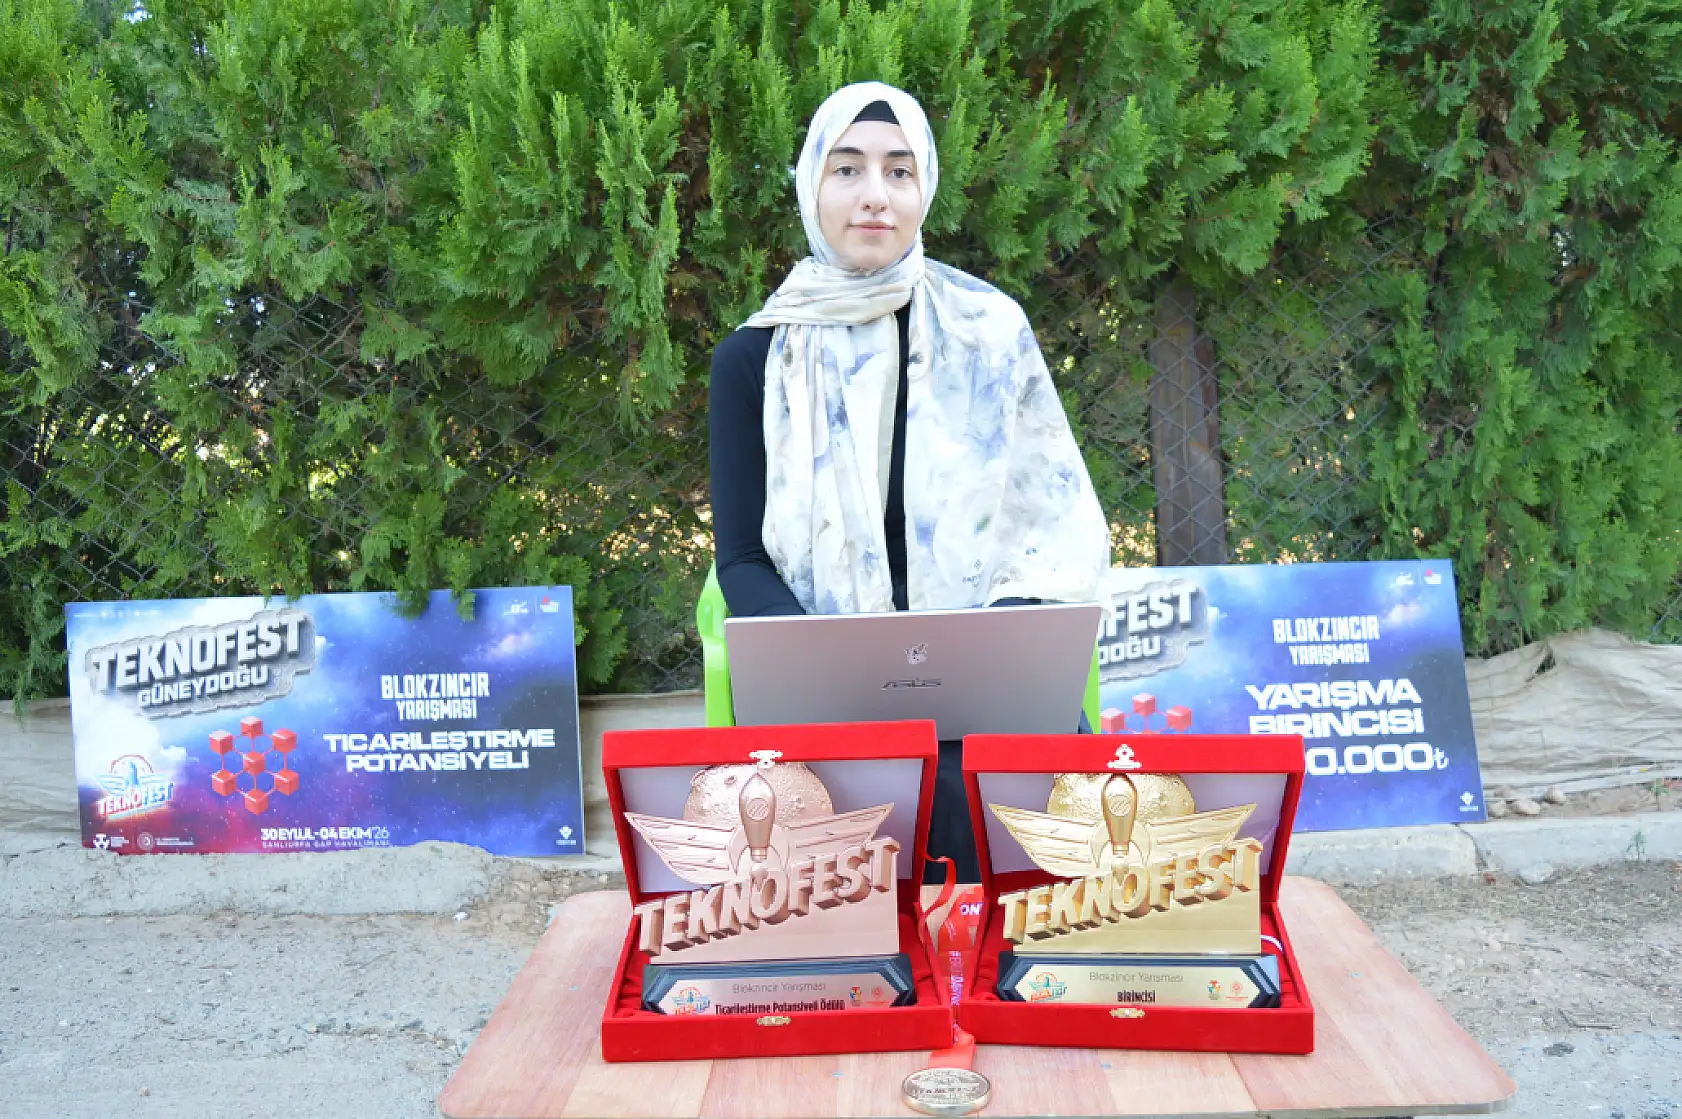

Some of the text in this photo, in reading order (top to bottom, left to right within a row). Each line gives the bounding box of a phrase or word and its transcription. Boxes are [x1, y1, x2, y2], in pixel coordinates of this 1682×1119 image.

[1098, 585, 1197, 637] FEST
[91, 613, 307, 691] TEKNOFEST
[1288, 643, 1370, 667] YARIŞMASI
[138, 663, 268, 706] GÜNEYDOĞU
[1244, 678, 1423, 710] YARIŞMA
[396, 698, 477, 721] YARIŞMASI
[96, 782, 174, 817] TEKNOFEST
[634, 836, 900, 957] TEKNOFEST
[997, 836, 1264, 945] TEKNOFEST
